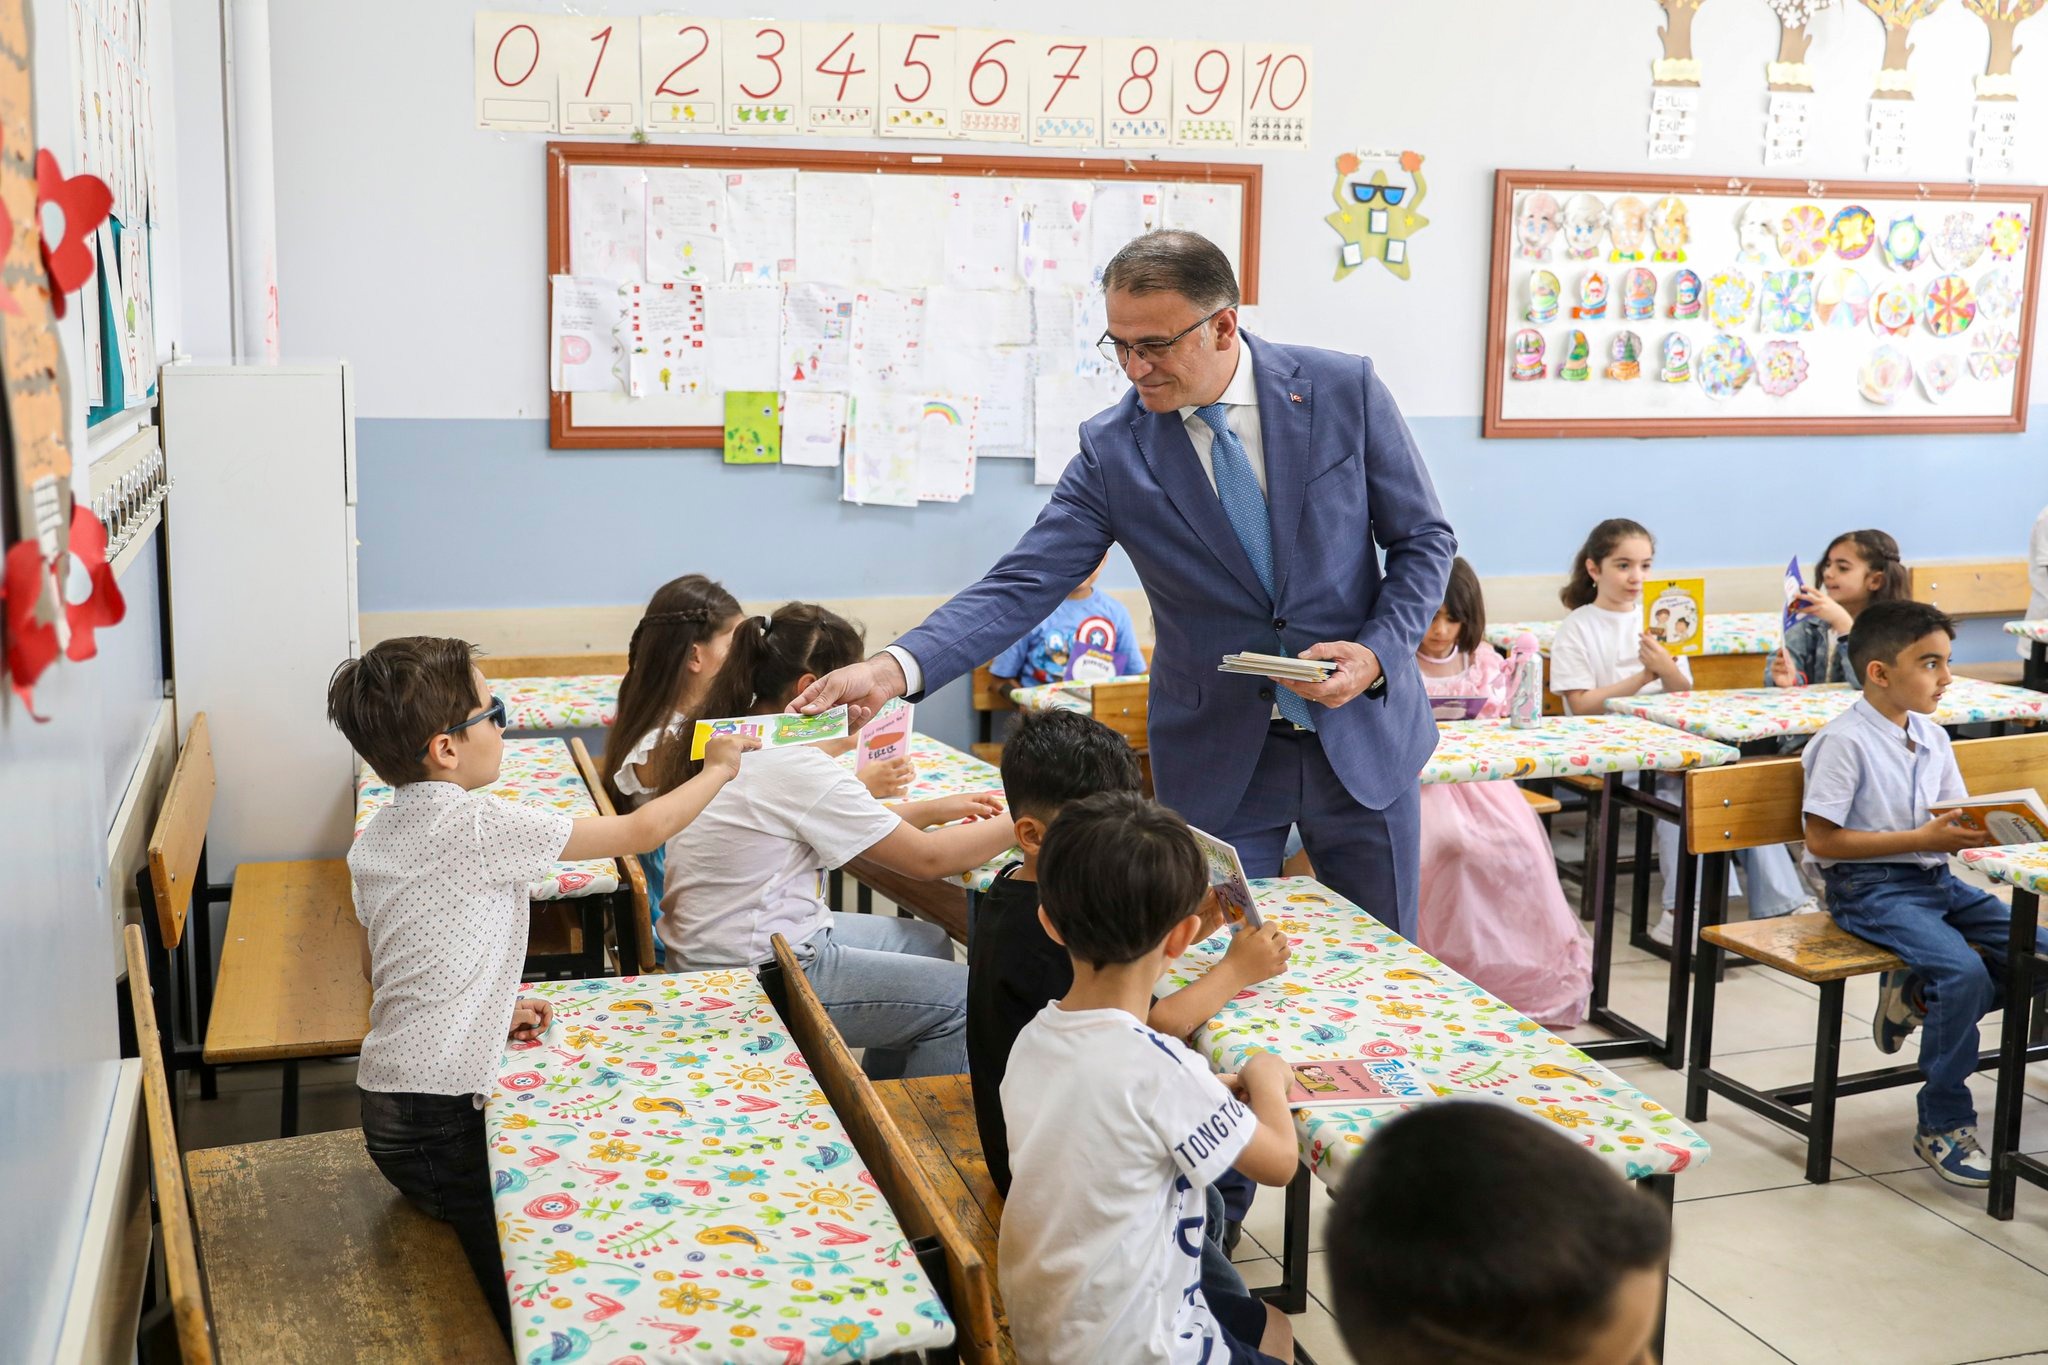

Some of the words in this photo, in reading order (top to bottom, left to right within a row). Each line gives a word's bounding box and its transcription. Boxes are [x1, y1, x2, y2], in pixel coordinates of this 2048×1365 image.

[493, 24, 540, 87] 0
[585, 26, 613, 97] 1
[655, 25, 709, 97] 2
[740, 28, 785, 100] 3
[816, 32, 865, 102] 4
[894, 33, 941, 103] 5
[968, 38, 1016, 107] 6
[1044, 44, 1088, 113] 7
[1118, 45, 1159, 116] 8
[1185, 48, 1231, 116] 9
[1249, 53, 1307, 112] 10
